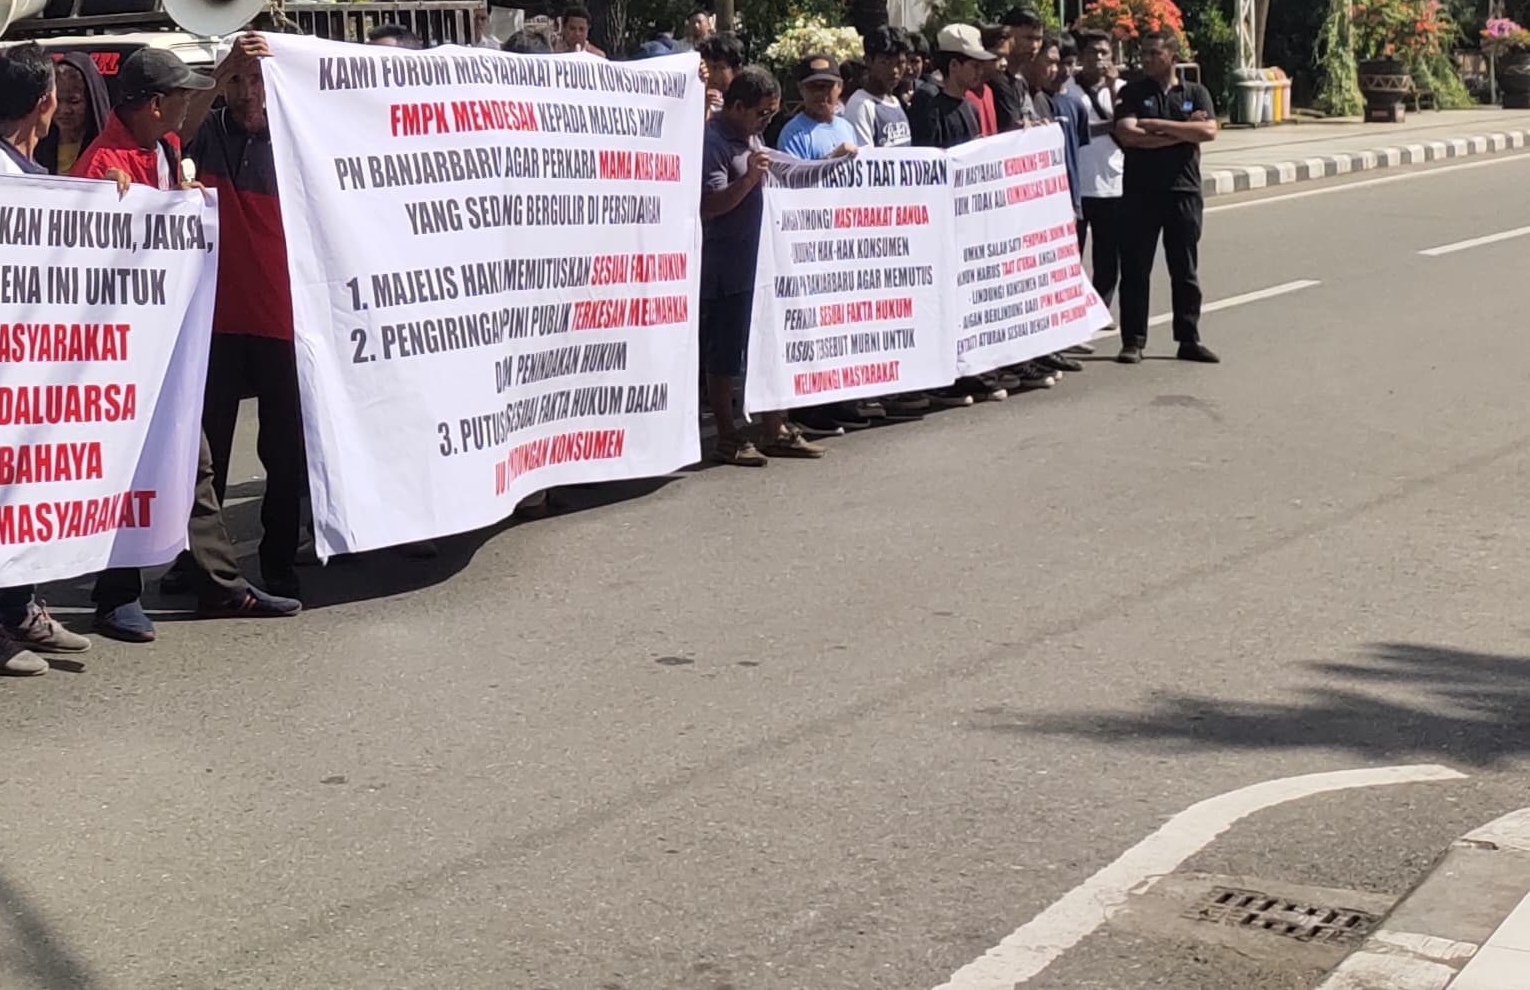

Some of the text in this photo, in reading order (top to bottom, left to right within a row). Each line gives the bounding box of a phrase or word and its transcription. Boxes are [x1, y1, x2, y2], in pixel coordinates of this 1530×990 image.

[320, 57, 377, 90] KAMI
[382, 55, 451, 87] FORUM
[451, 55, 552, 87] MASYARAKAT
[553, 60, 597, 90] PEDULI
[390, 102, 449, 136] FMPK
[451, 100, 538, 132] MENDESAK
[537, 103, 588, 133] KEPADA
[588, 105, 638, 136] MAJELIS
[334, 157, 365, 190] PN
[367, 146, 501, 188] BANJARBARU
[505, 147, 539, 178] AGAR
[542, 148, 596, 179] PERKARA
[599, 150, 631, 179] MAMA
[867, 159, 895, 187] TAAT
[900, 159, 947, 186] ATURAN
[48, 210, 137, 254] HUKUM,
[405, 199, 463, 235] YANG
[527, 194, 584, 225] BERGULIR
[588, 195, 599, 224] DI
[818, 238, 854, 261] HAK-HAK
[857, 236, 910, 259] KONSUMEN
[48, 267, 79, 304] INI
[86, 269, 166, 305] UNTUK
[346, 277, 368, 310] 1.
[371, 266, 458, 308] MAJELIS
[503, 256, 591, 291] MEMUTUSKAN
[591, 254, 629, 285] SESUAI
[658, 253, 686, 281] HUKUM
[857, 268, 881, 290] AGAR
[884, 265, 933, 288] MEMUTUS
[847, 300, 873, 324] FAKTA
[875, 297, 912, 320] HUKUM
[350, 328, 376, 363] 2.
[531, 303, 571, 336] PUBLIK
[572, 298, 626, 331] TERKESAN
[785, 340, 815, 363] KASUS
[850, 331, 880, 355] MURNI
[882, 328, 915, 351] UNTUK
[516, 347, 578, 384] PENINDAKAN
[580, 341, 627, 373] HUKUM
[841, 361, 899, 388] MASYARAKAT
[438, 422, 457, 456] 3.
[537, 391, 570, 424] FAKTA
[571, 386, 623, 417] HUKUM
[625, 383, 667, 414] DALAM
[549, 429, 625, 465] KONSUMEN
